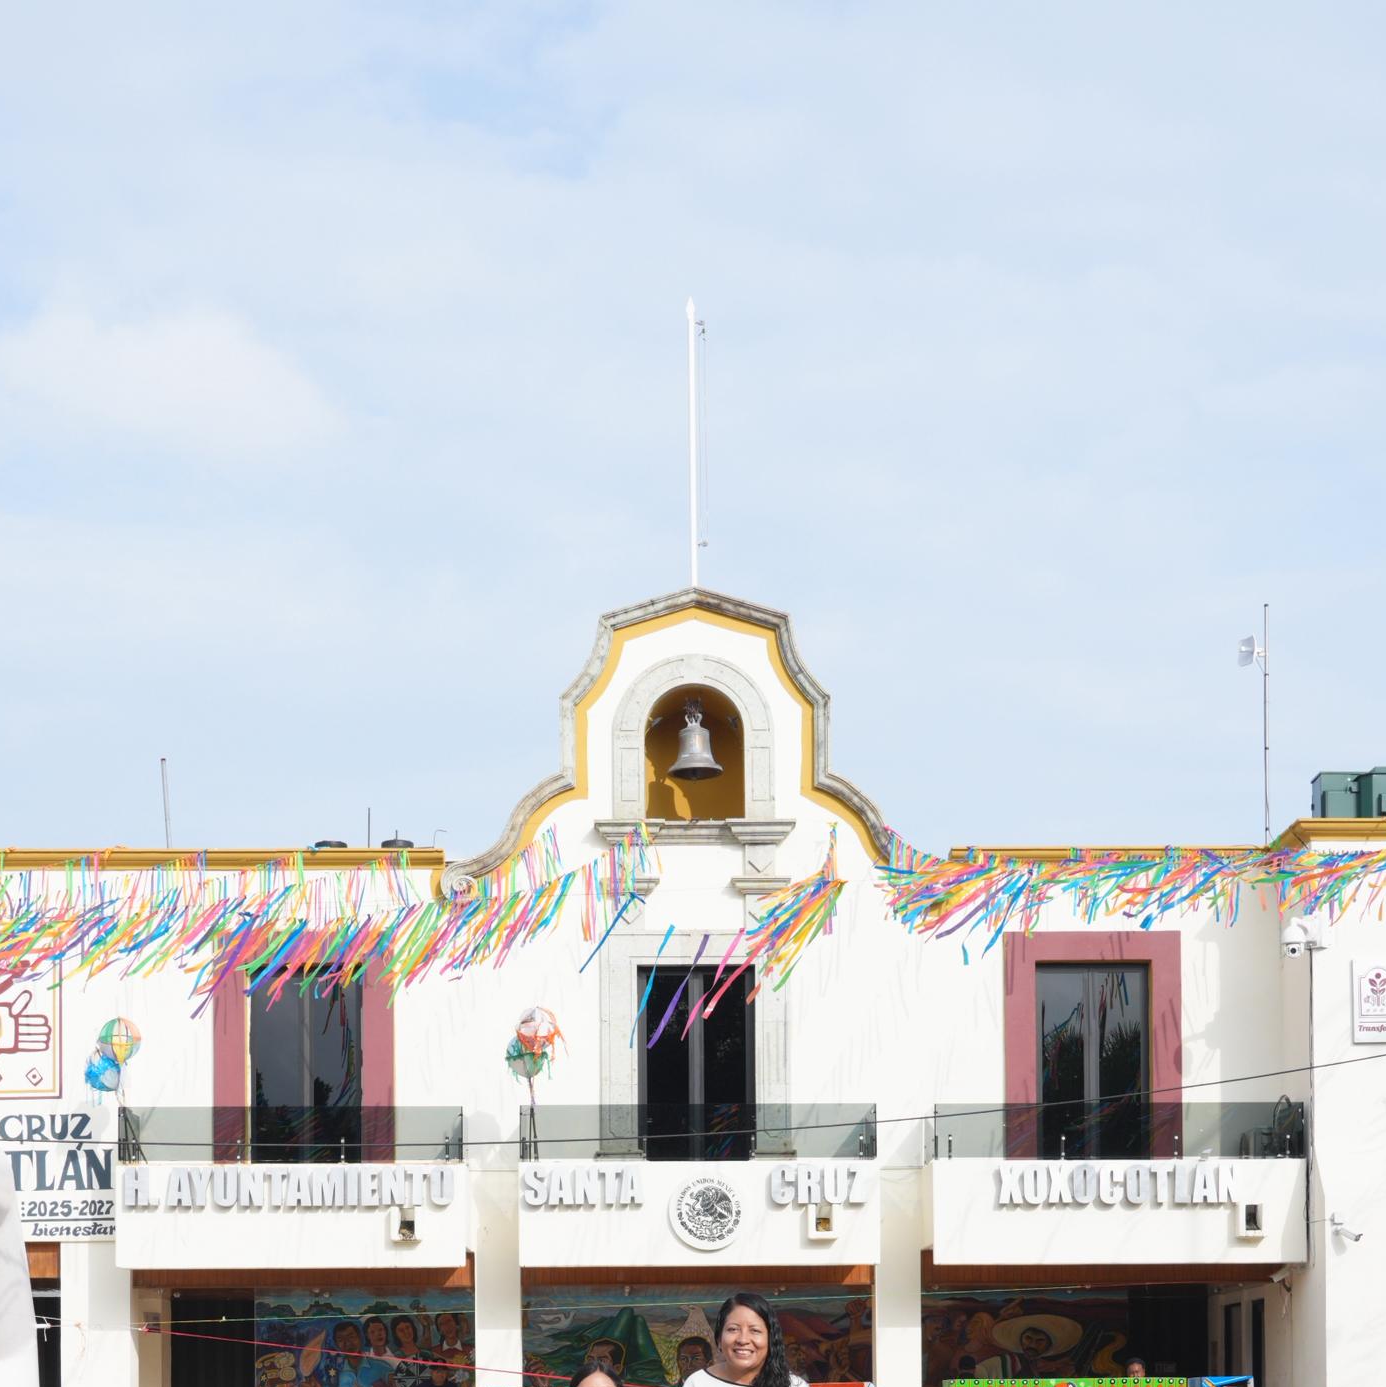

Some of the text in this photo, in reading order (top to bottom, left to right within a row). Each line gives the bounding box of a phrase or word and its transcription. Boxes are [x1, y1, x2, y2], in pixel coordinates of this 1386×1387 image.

[124, 1166, 455, 1208] H. AYUNTAMIENTO
[523, 1164, 868, 1207] SANTA CRUZ
[31, 1222, 116, 1237] bienestar
